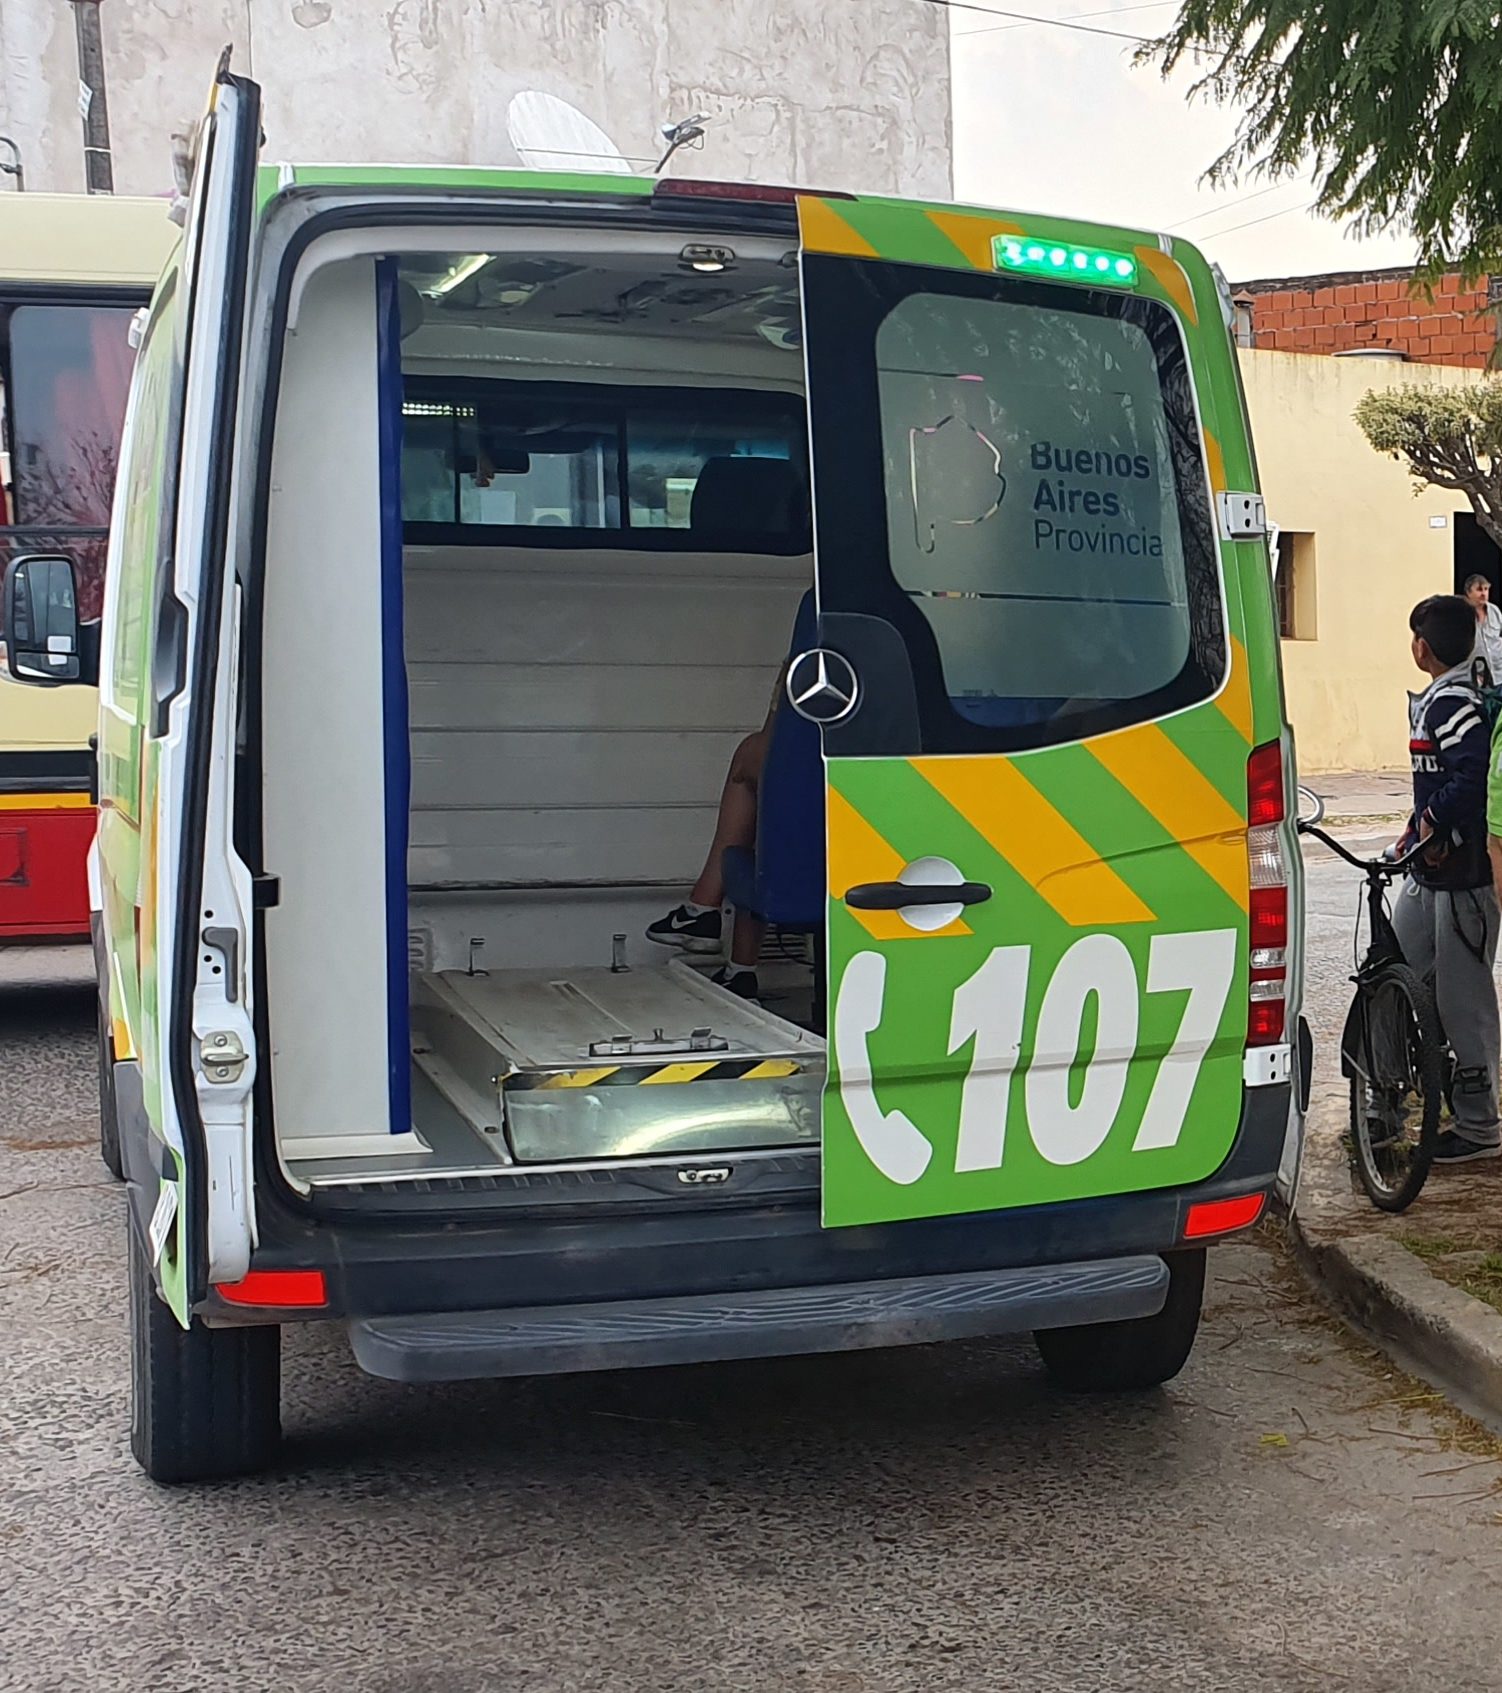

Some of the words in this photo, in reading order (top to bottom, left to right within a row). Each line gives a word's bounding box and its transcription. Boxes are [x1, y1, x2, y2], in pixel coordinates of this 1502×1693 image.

[1030, 441, 1151, 479] Buenos
[1033, 478, 1121, 517] Aires
[1034, 518, 1164, 557] Provincia
[947, 928, 1238, 1173] 107
